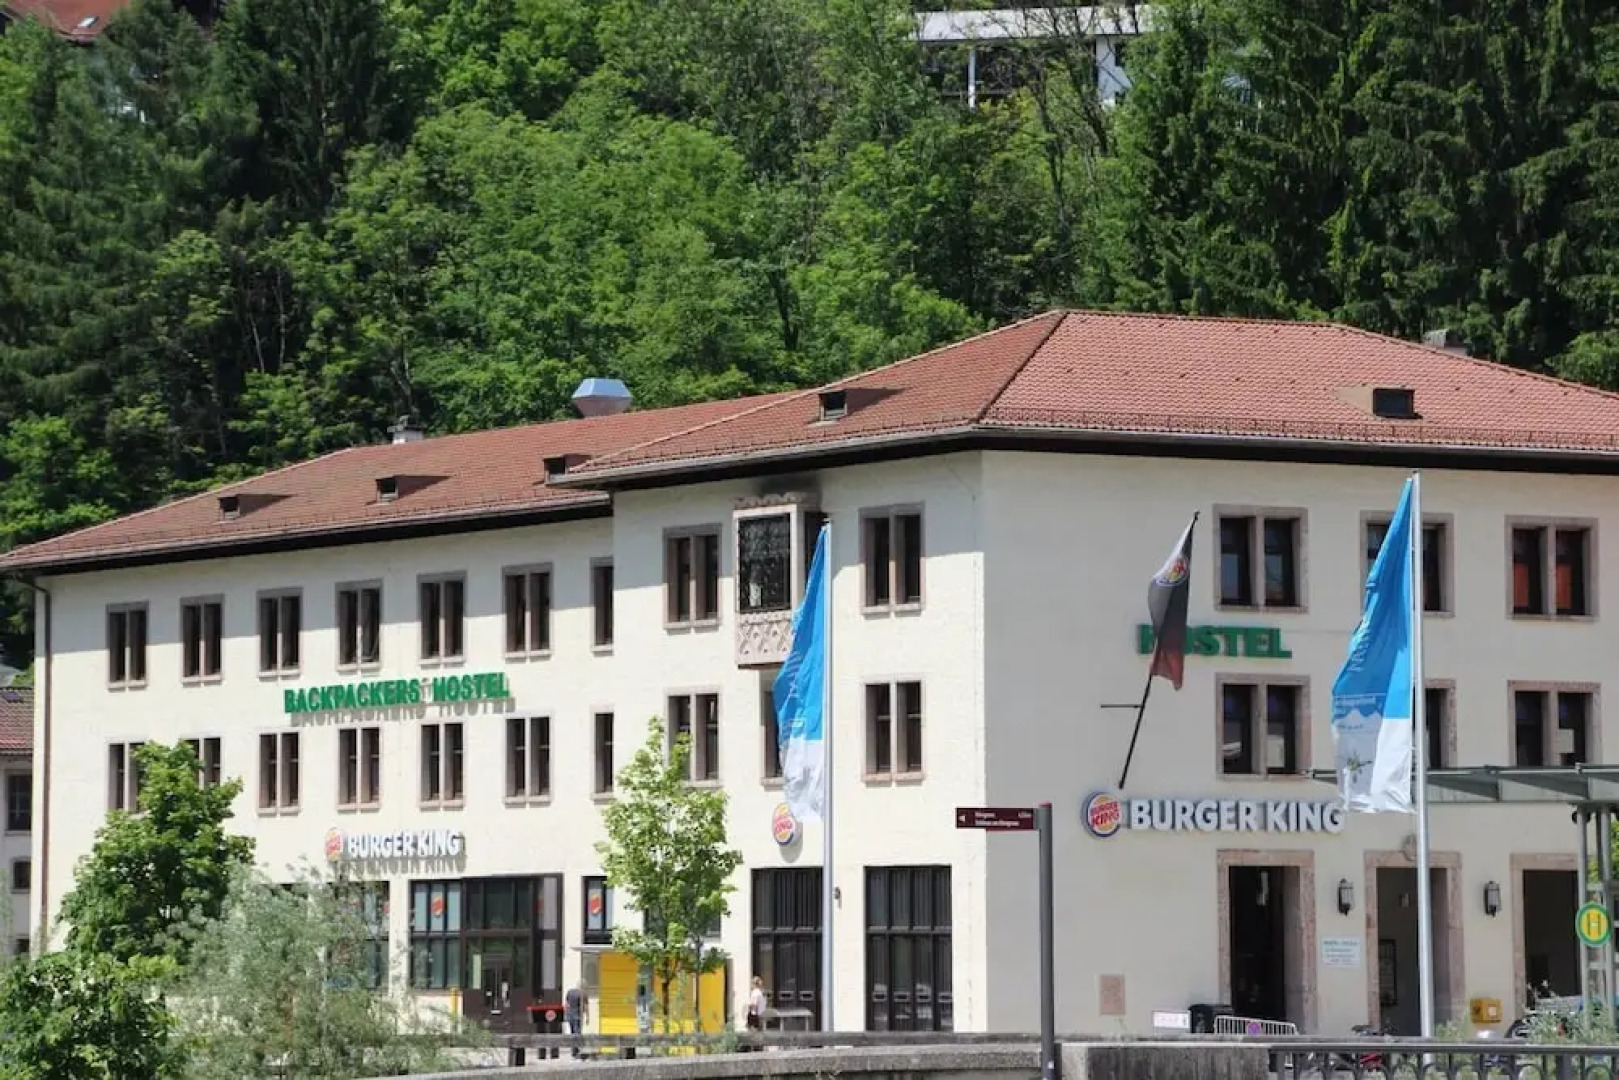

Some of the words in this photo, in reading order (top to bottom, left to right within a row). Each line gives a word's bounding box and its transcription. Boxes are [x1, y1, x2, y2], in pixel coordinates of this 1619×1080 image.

[284, 679, 420, 713] BACKPACKERS
[432, 672, 510, 702] HOSTEL
[1130, 799, 1258, 831] BURGER
[1266, 801, 1345, 832] KING
[348, 833, 413, 858] BURGER
[417, 830, 462, 857] KING
[1587, 912, 1601, 936] H
